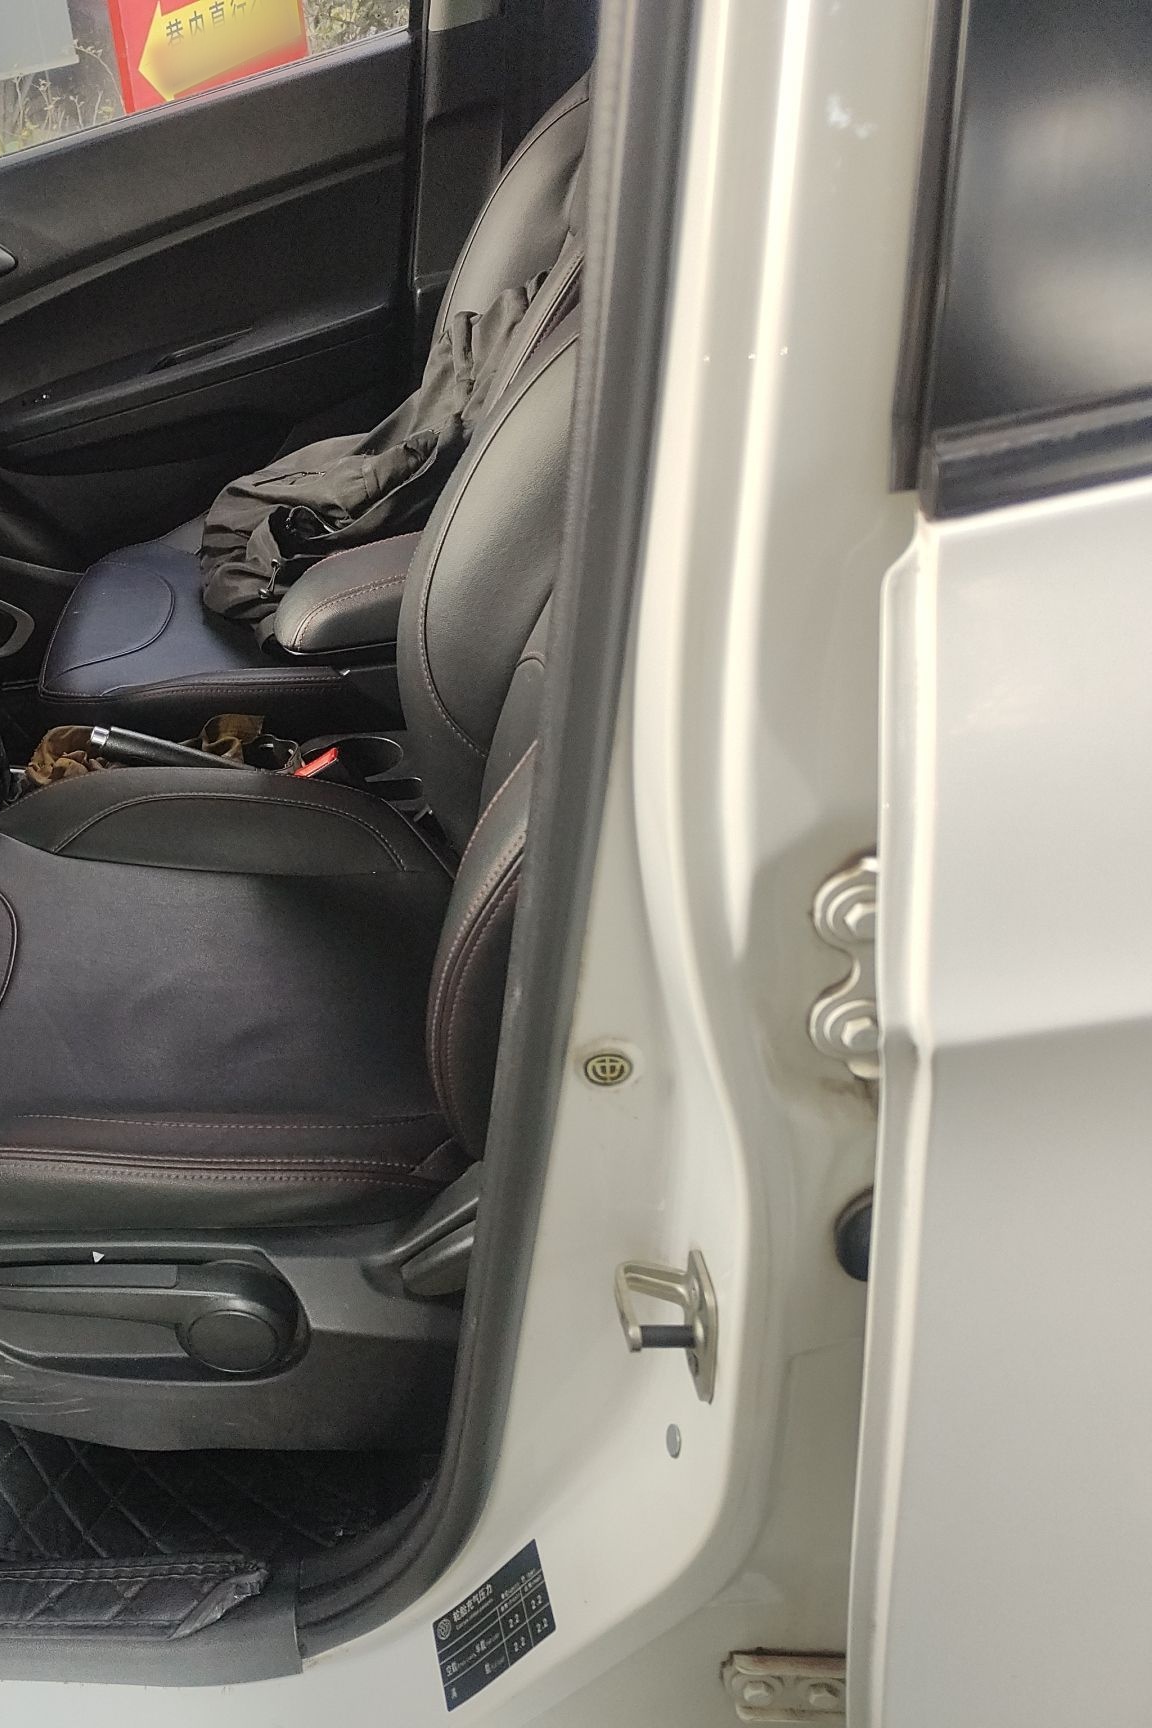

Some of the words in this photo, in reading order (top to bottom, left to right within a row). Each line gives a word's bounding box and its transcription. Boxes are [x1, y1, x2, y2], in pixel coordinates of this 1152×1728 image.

[531, 1594, 543, 1610] 2.2
[508, 1613, 520, 1628] 2.2
[536, 1617, 548, 1633] 2.2
[513, 1636, 526, 1652] 2.2
